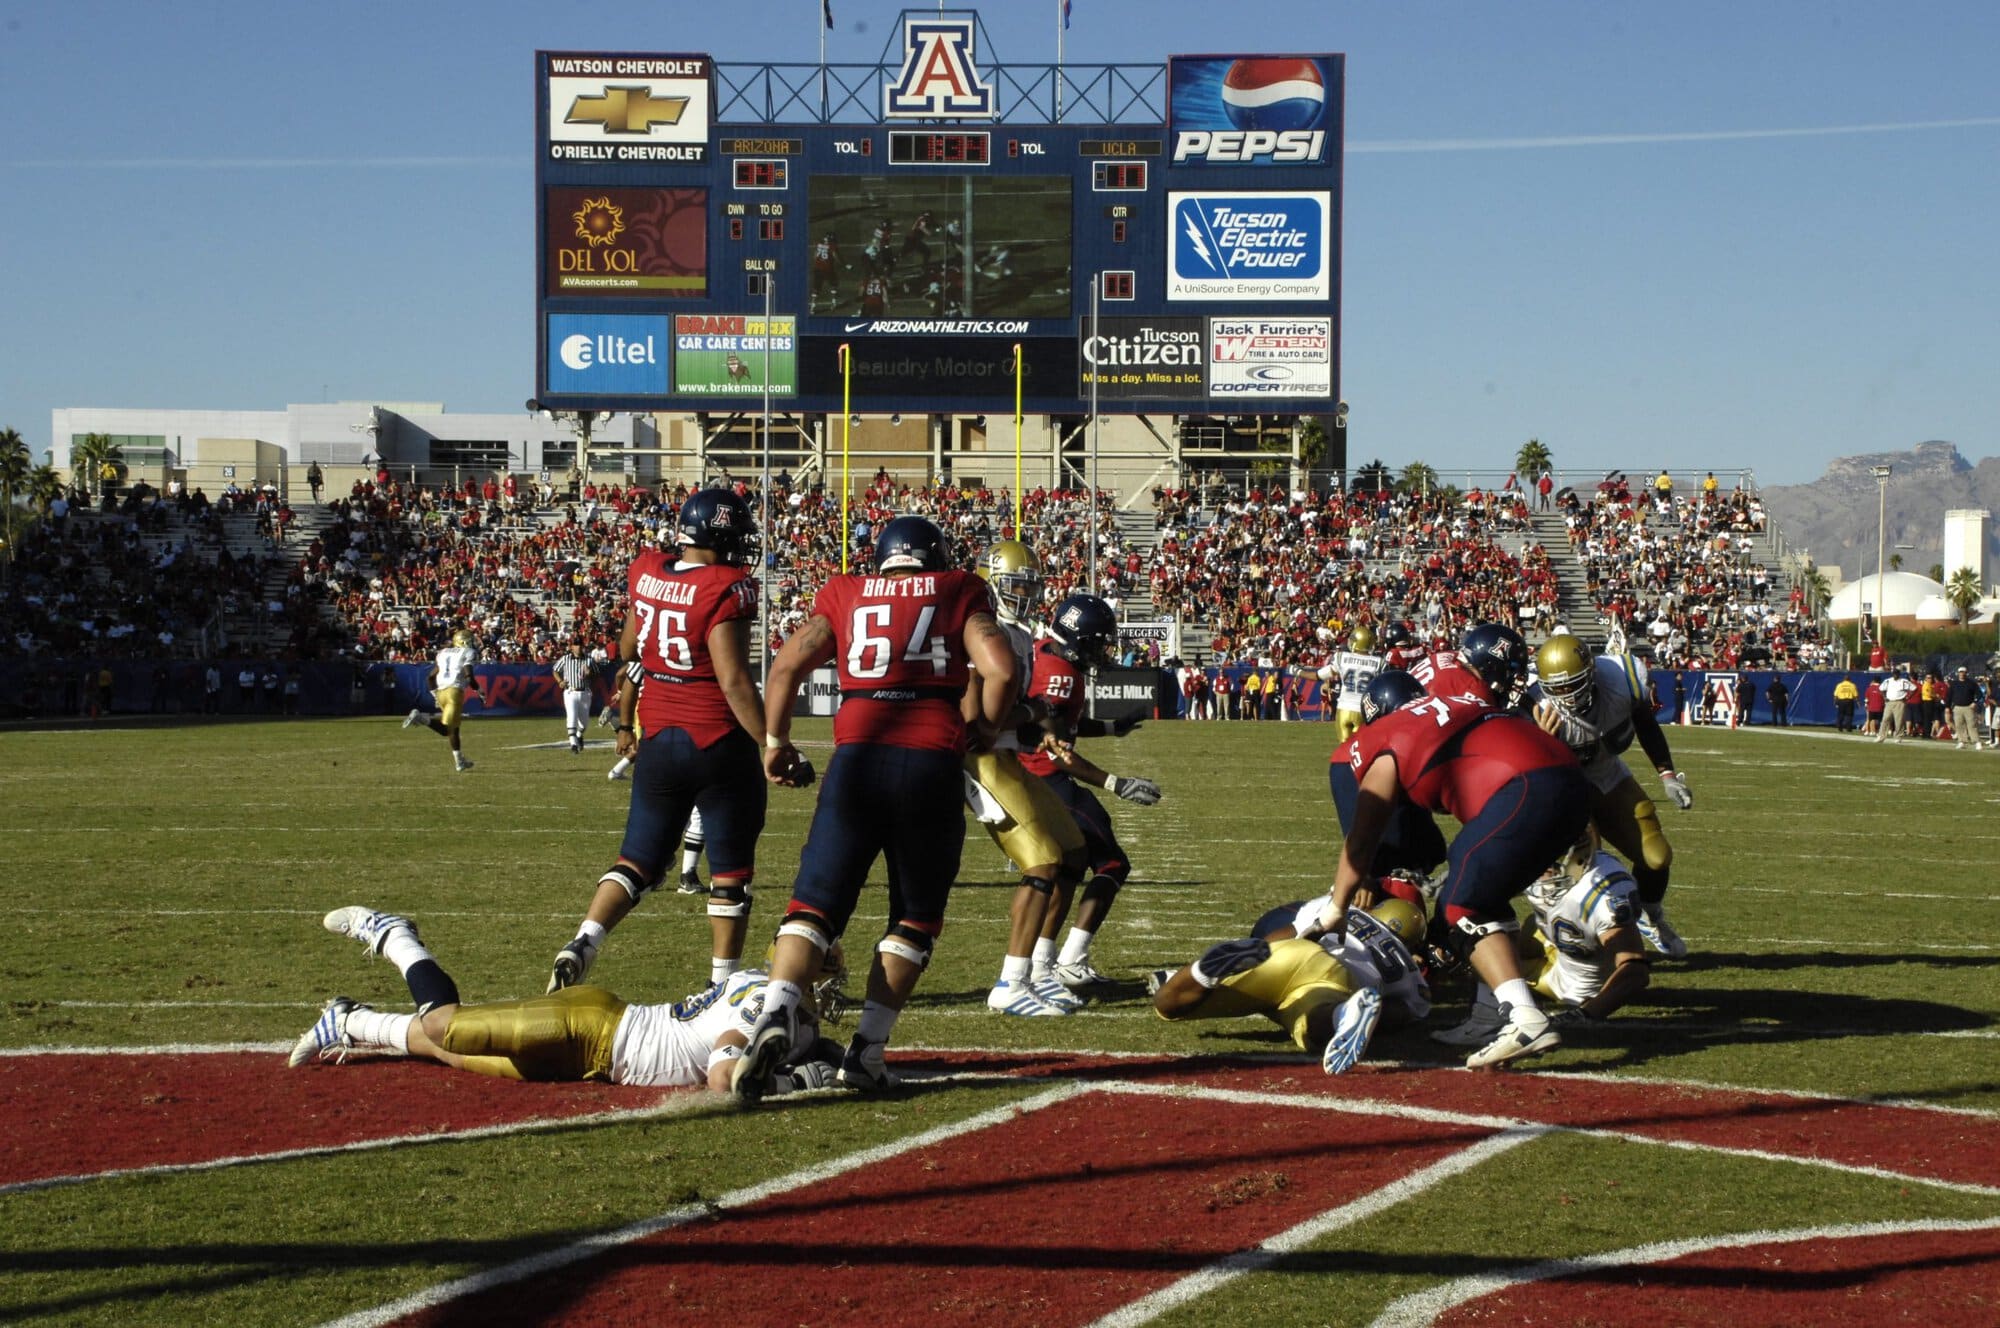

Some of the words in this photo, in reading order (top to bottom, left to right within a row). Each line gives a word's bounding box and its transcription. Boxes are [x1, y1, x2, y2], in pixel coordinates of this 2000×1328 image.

[552, 59, 612, 73] WATSON
[616, 60, 703, 75] CHEVROLET
[885, 20, 993, 117] A
[551, 145, 614, 159] O'RIELLY
[617, 146, 703, 160] CHEVROLET
[733, 140, 789, 153] ARIZONA
[834, 142, 858, 153] TOL
[1021, 143, 1045, 154] TOL
[1102, 142, 1136, 155] UCLA
[1173, 130, 1326, 163] PEPSI
[727, 204, 745, 215] DWN
[760, 204, 769, 215] TO
[771, 204, 783, 215] GO
[1112, 206, 1127, 218] QTR
[1212, 208, 1287, 228] Tucson
[1218, 229, 1307, 248] Electric
[559, 249, 596, 272] DEL
[603, 249, 640, 272] SOL
[745, 259, 762, 270] BALL
[764, 260, 775, 270] ON
[1228, 250, 1306, 268] Power
[562, 277, 638, 287] AVAconcerts.com
[1174, 285, 1182, 293] A
[1184, 284, 1234, 293] UniSource
[1236, 285, 1271, 296] Energy
[1274, 285, 1320, 296] Company
[868, 321, 1029, 334] ARIZONAATHLETICS.COM
[1216, 324, 1254, 335] Jack
[1260, 324, 1326, 335] Furrier's
[1140, 327, 1199, 343] Tucson
[577, 335, 655, 364] alltel
[679, 337, 702, 350] CAR
[706, 337, 737, 350] CARE
[1083, 335, 1202, 365] Citizen
[1216, 336, 1326, 360] WESTERN
[1248, 350, 1267, 358] TIRE
[1278, 350, 1300, 358] AUTO
[935, 357, 994, 376] Motor
[1082, 373, 1108, 383] Mss
[1111, 375, 1118, 383] a
[1121, 373, 1143, 385] day.
[1146, 373, 1171, 383] Miss
[1175, 375, 1182, 383] a
[1184, 373, 1202, 383] lot.
[1645, 476, 1654, 486] 30
[862, 576, 936, 597] BAXTER
[1598, 617, 1610, 625] 30
[634, 599, 694, 671] 76
[1117, 628, 1167, 639] RUEGGER'S
[847, 604, 951, 678] 64
[1046, 675, 1074, 698] 23
[1344, 668, 1372, 692] 42
[813, 682, 840, 697] MUS
[873, 690, 916, 699] ARIZONA
